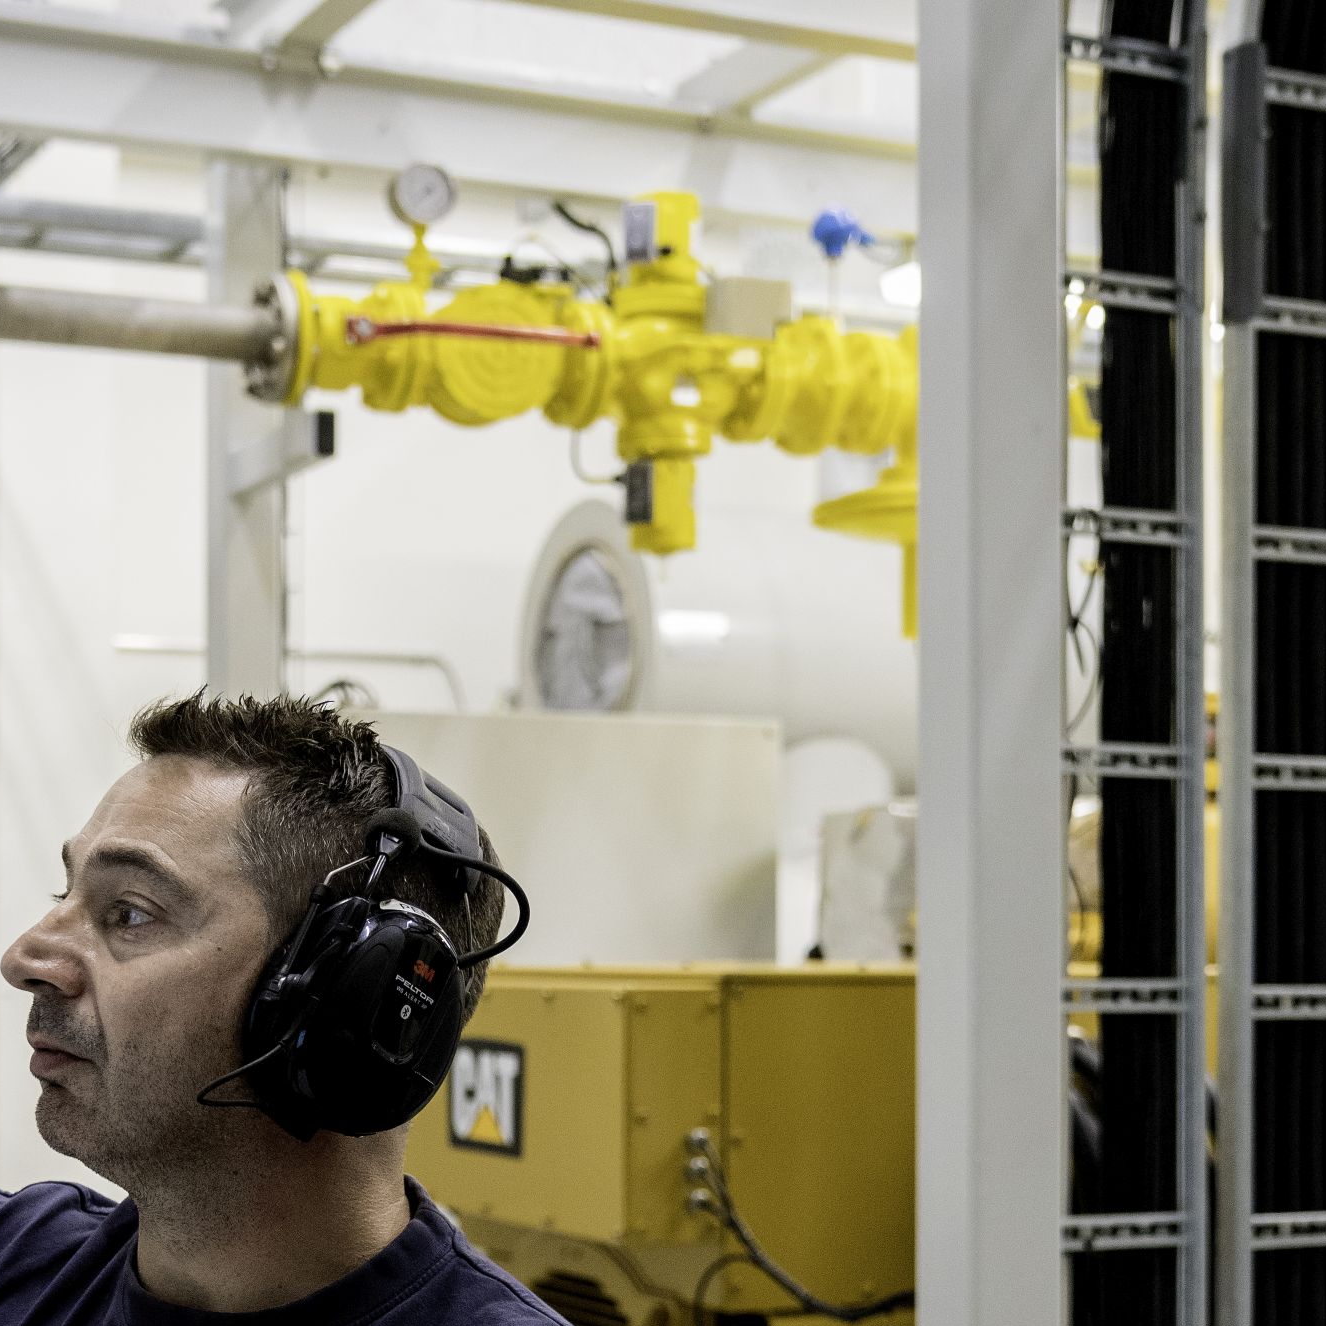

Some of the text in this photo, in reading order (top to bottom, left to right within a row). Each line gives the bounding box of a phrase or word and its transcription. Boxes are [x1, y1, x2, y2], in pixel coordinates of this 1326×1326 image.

[414, 960, 435, 982] 3M
[395, 974, 434, 1005] PELTOR
[404, 991, 421, 1005] ALERT
[451, 1045, 519, 1147] CAT
